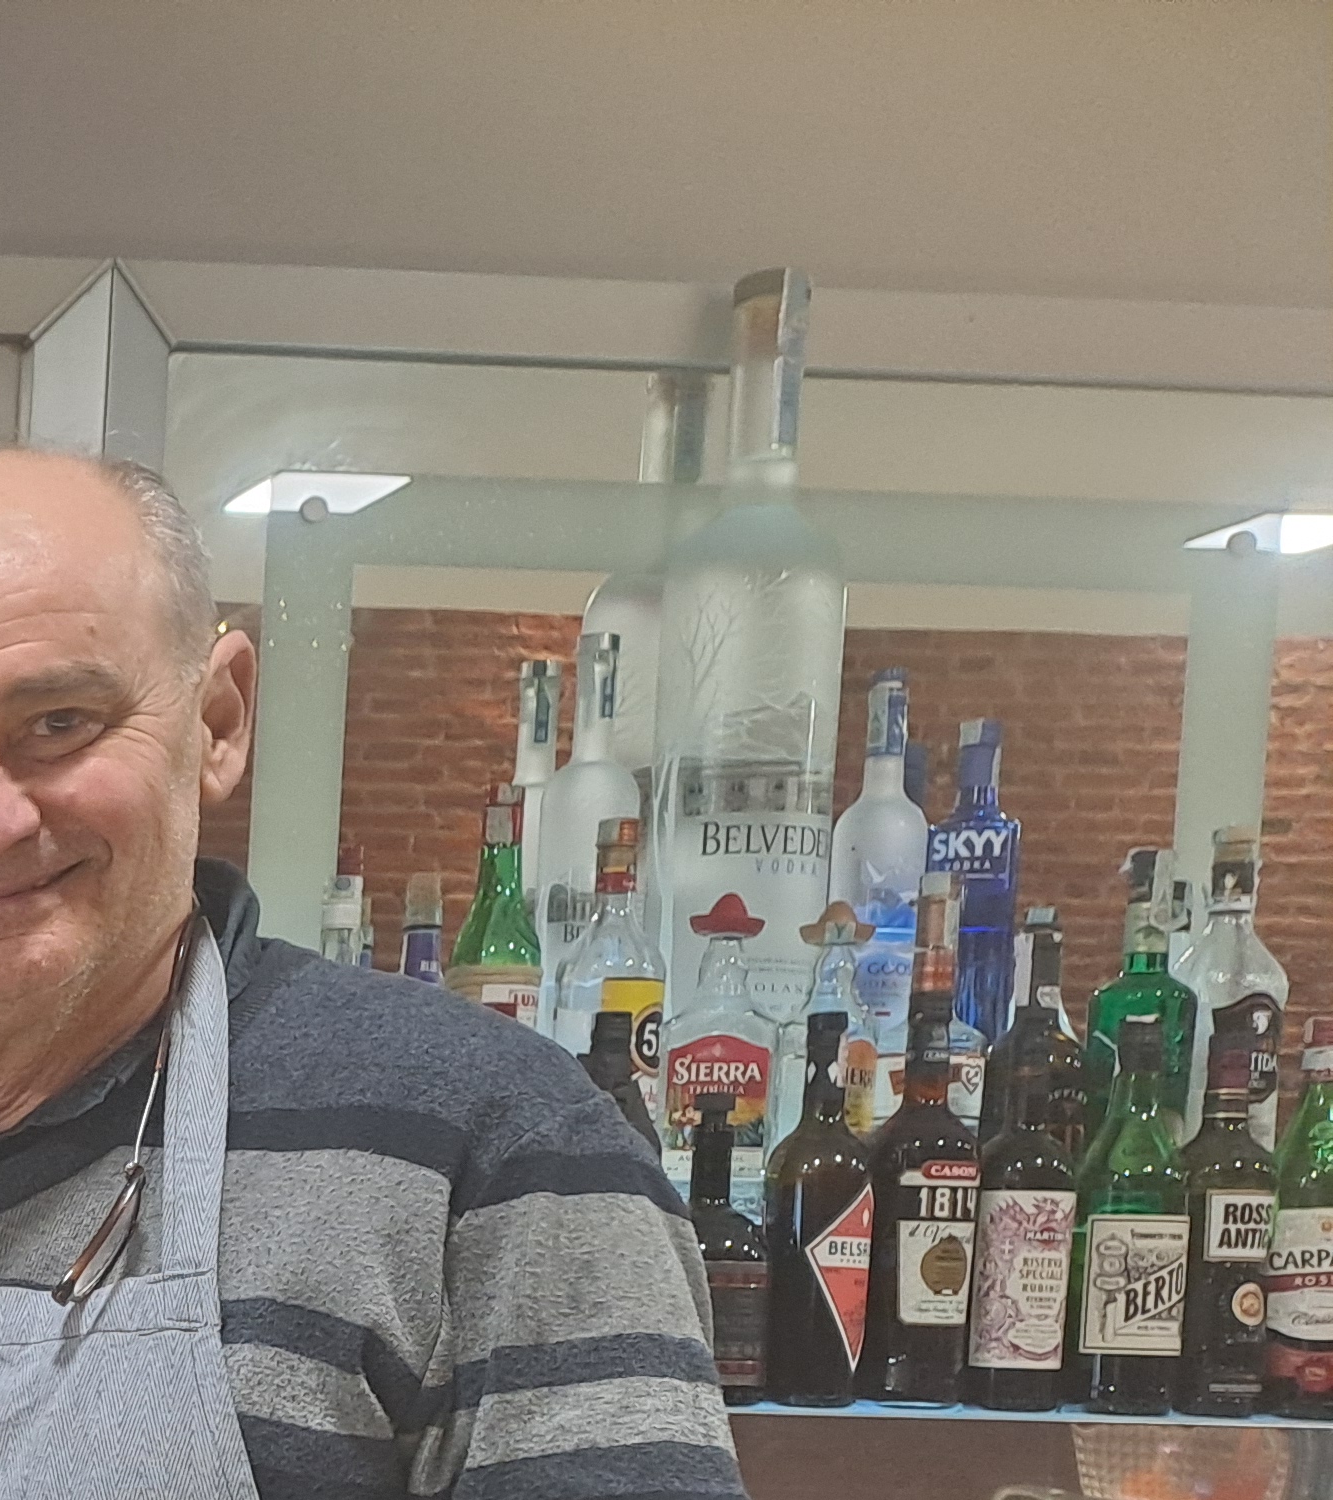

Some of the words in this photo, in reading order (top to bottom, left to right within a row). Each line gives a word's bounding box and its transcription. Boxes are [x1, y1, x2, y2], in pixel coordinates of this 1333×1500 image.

[933, 829, 1007, 861] SKYY
[672, 1054, 763, 1085] SIERRA
[919, 1187, 978, 1219] 1814
[1124, 1262, 1184, 1323] BERTO
